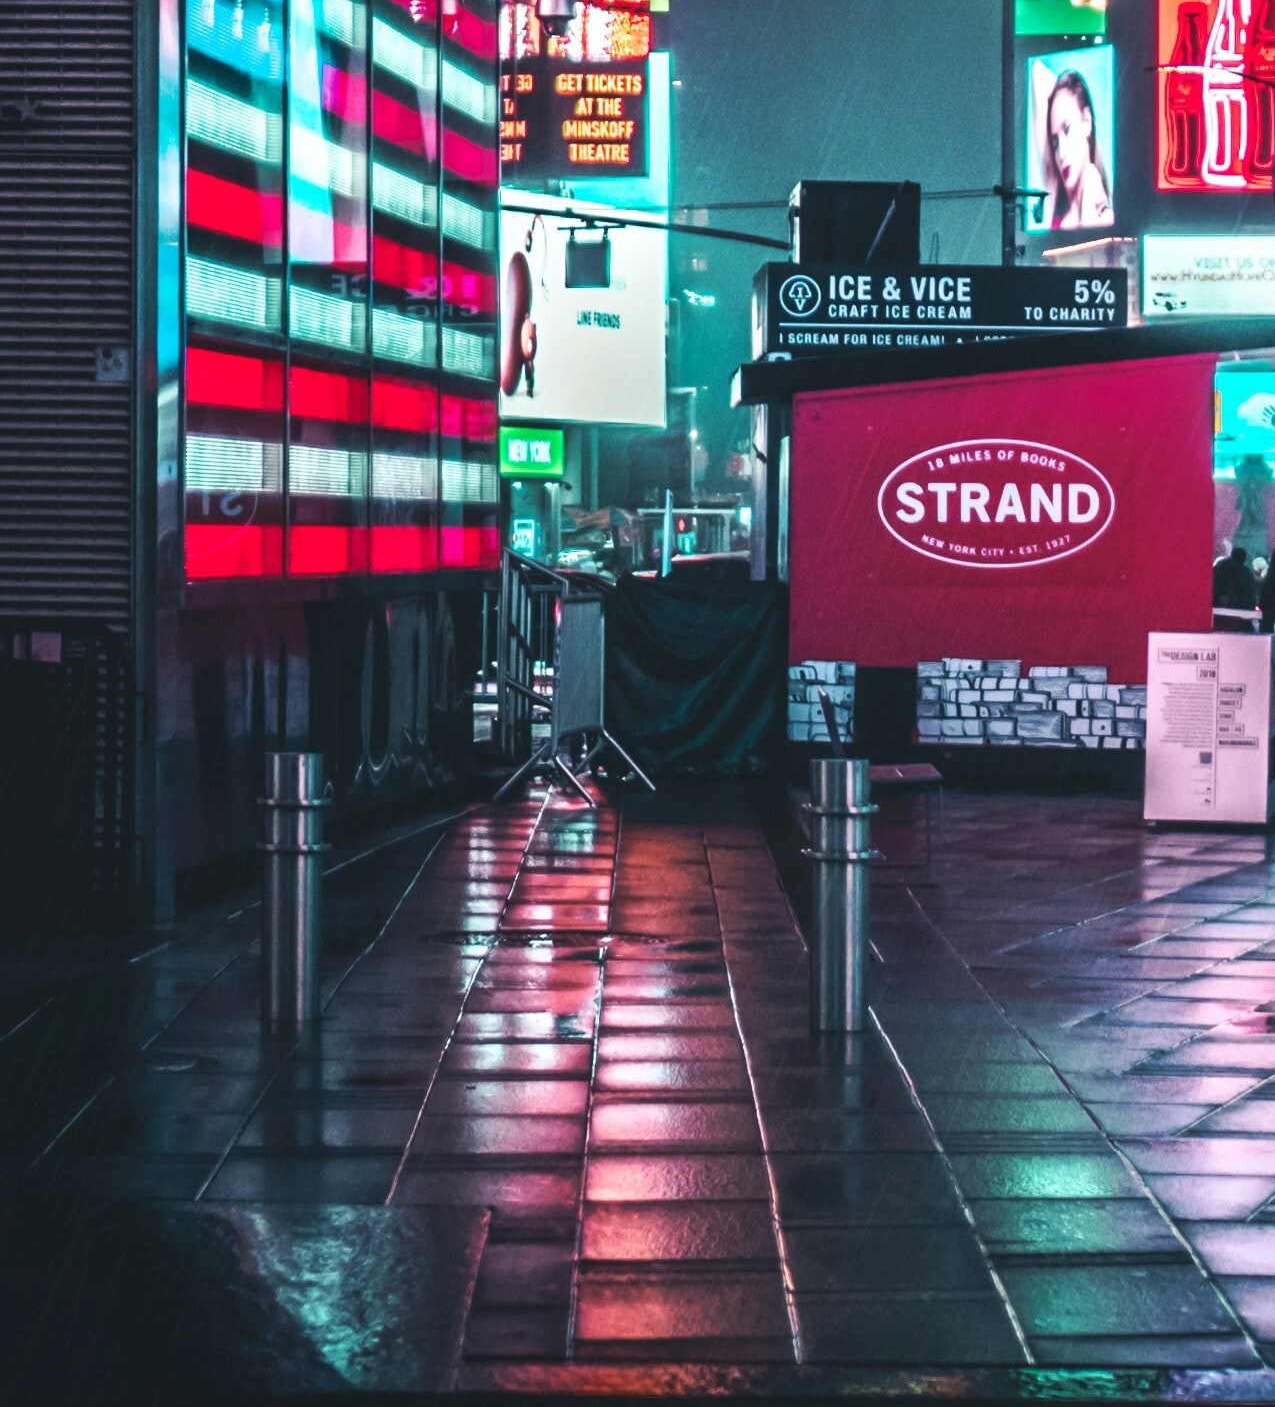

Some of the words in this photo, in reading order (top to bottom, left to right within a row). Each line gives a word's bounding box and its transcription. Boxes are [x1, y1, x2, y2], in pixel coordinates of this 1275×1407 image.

[556, 74, 582, 92] GET
[585, 74, 642, 92] TICKETS
[575, 98, 593, 115] AT
[597, 98, 621, 115] THE
[563, 121, 634, 139] MINSKOFF
[570, 144, 629, 162] THEATRE
[1194, 258, 1230, 268] VISIT
[1237, 258, 1254, 268] US
[829, 275, 872, 300] ICE
[882, 277, 901, 301] &
[911, 278, 972, 302] VICE
[1074, 280, 1115, 305] 5%
[577, 311, 592, 326] LINE
[593, 312, 621, 329] FRIENDS
[828, 304, 878, 317] CRAFT
[885, 305, 910, 318] ICE
[917, 306, 972, 319] CREAM
[1024, 307, 1044, 320] TO
[1050, 307, 1115, 321] CHARITY
[787, 333, 839, 345] SCREAM
[844, 334, 868, 346] FOR
[872, 335, 892, 346] ICE
[508, 440, 528, 461] NEW
[530, 441, 550, 463] YORK
[928, 458, 944, 471] 18
[949, 450, 991, 465] MILES
[997, 450, 1015, 460] OF
[1020, 452, 1066, 472] BOOKS
[895, 482, 1100, 524] STRAND
[921, 534, 945, 549] NEW
[949, 543, 976, 555] YORK
[981, 547, 1004, 556] CITY
[1045, 534, 1071, 550] 1927
